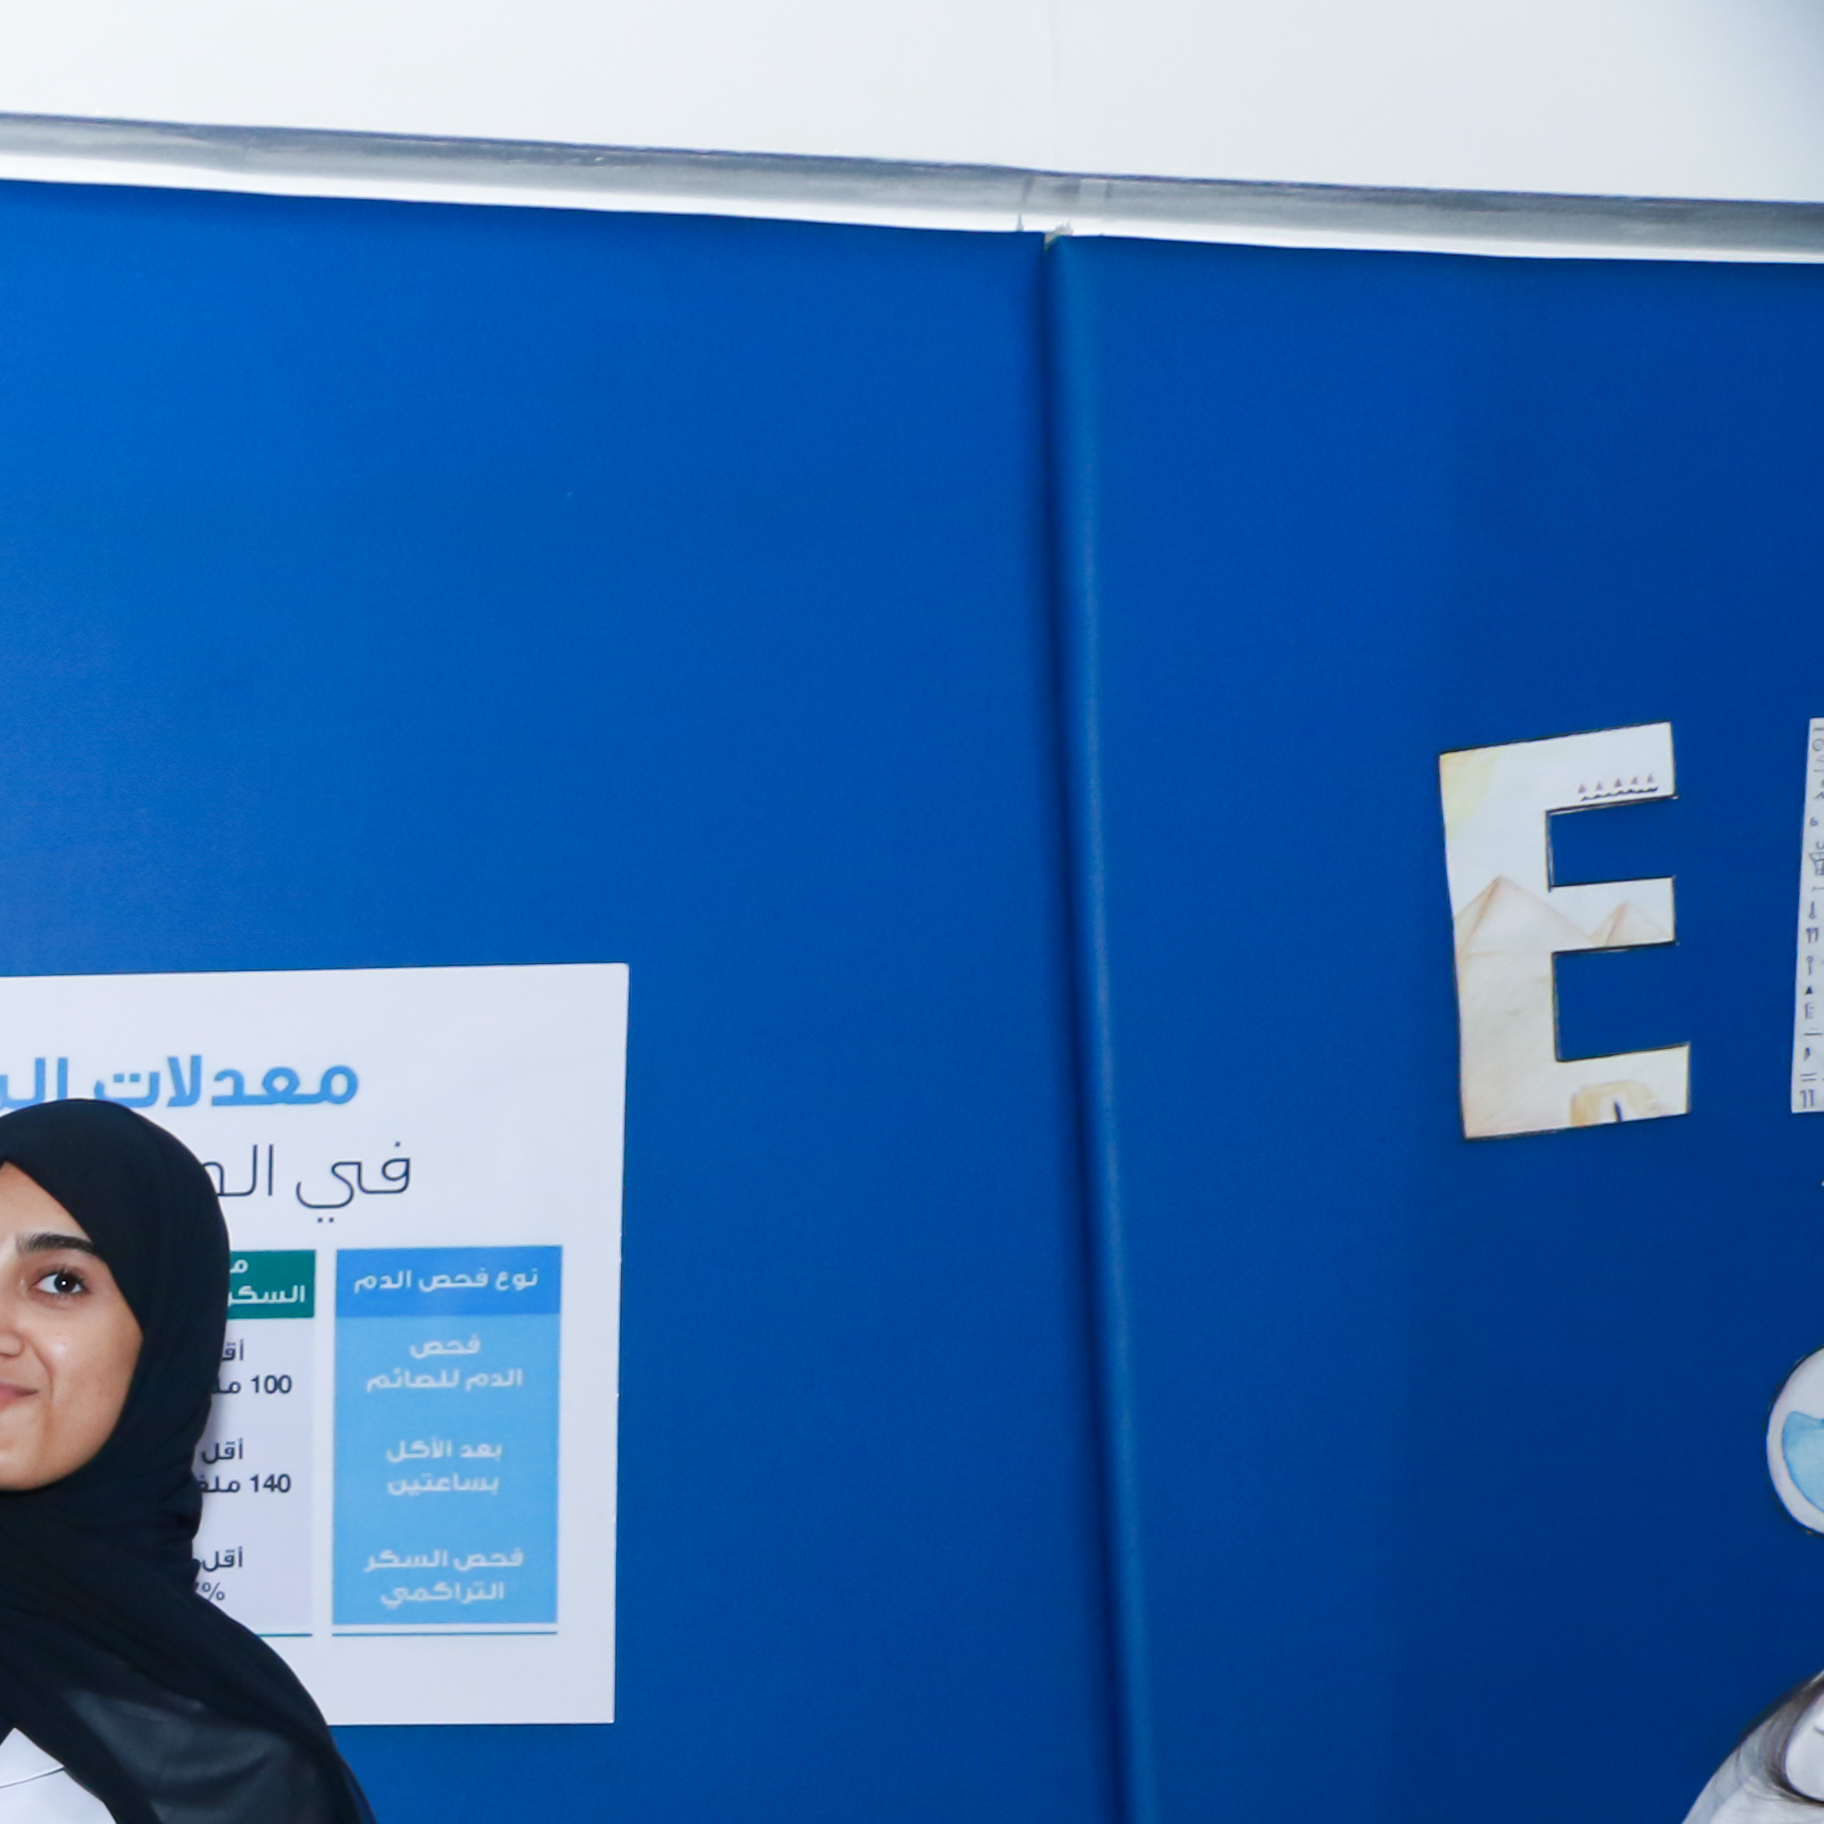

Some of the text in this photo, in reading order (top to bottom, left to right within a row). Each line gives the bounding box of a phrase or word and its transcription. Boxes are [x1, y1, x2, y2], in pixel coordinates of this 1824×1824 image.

[93, 1054, 359, 1109] معدلات
[296, 1141, 412, 1223] في
[354, 1267, 539, 1294] نوع فحص الدم
[410, 1334, 482, 1359] فحص
[250, 1374, 293, 1395] 100
[366, 1368, 523, 1392] الدم للصائم
[202, 1438, 244, 1462] أقل
[386, 1438, 503, 1463] بعد الأكل
[250, 1473, 292, 1494] 140
[387, 1474, 500, 1497] بساعتين
[364, 1547, 524, 1573] فحص السكر
[380, 1581, 505, 1610] التراكمي
